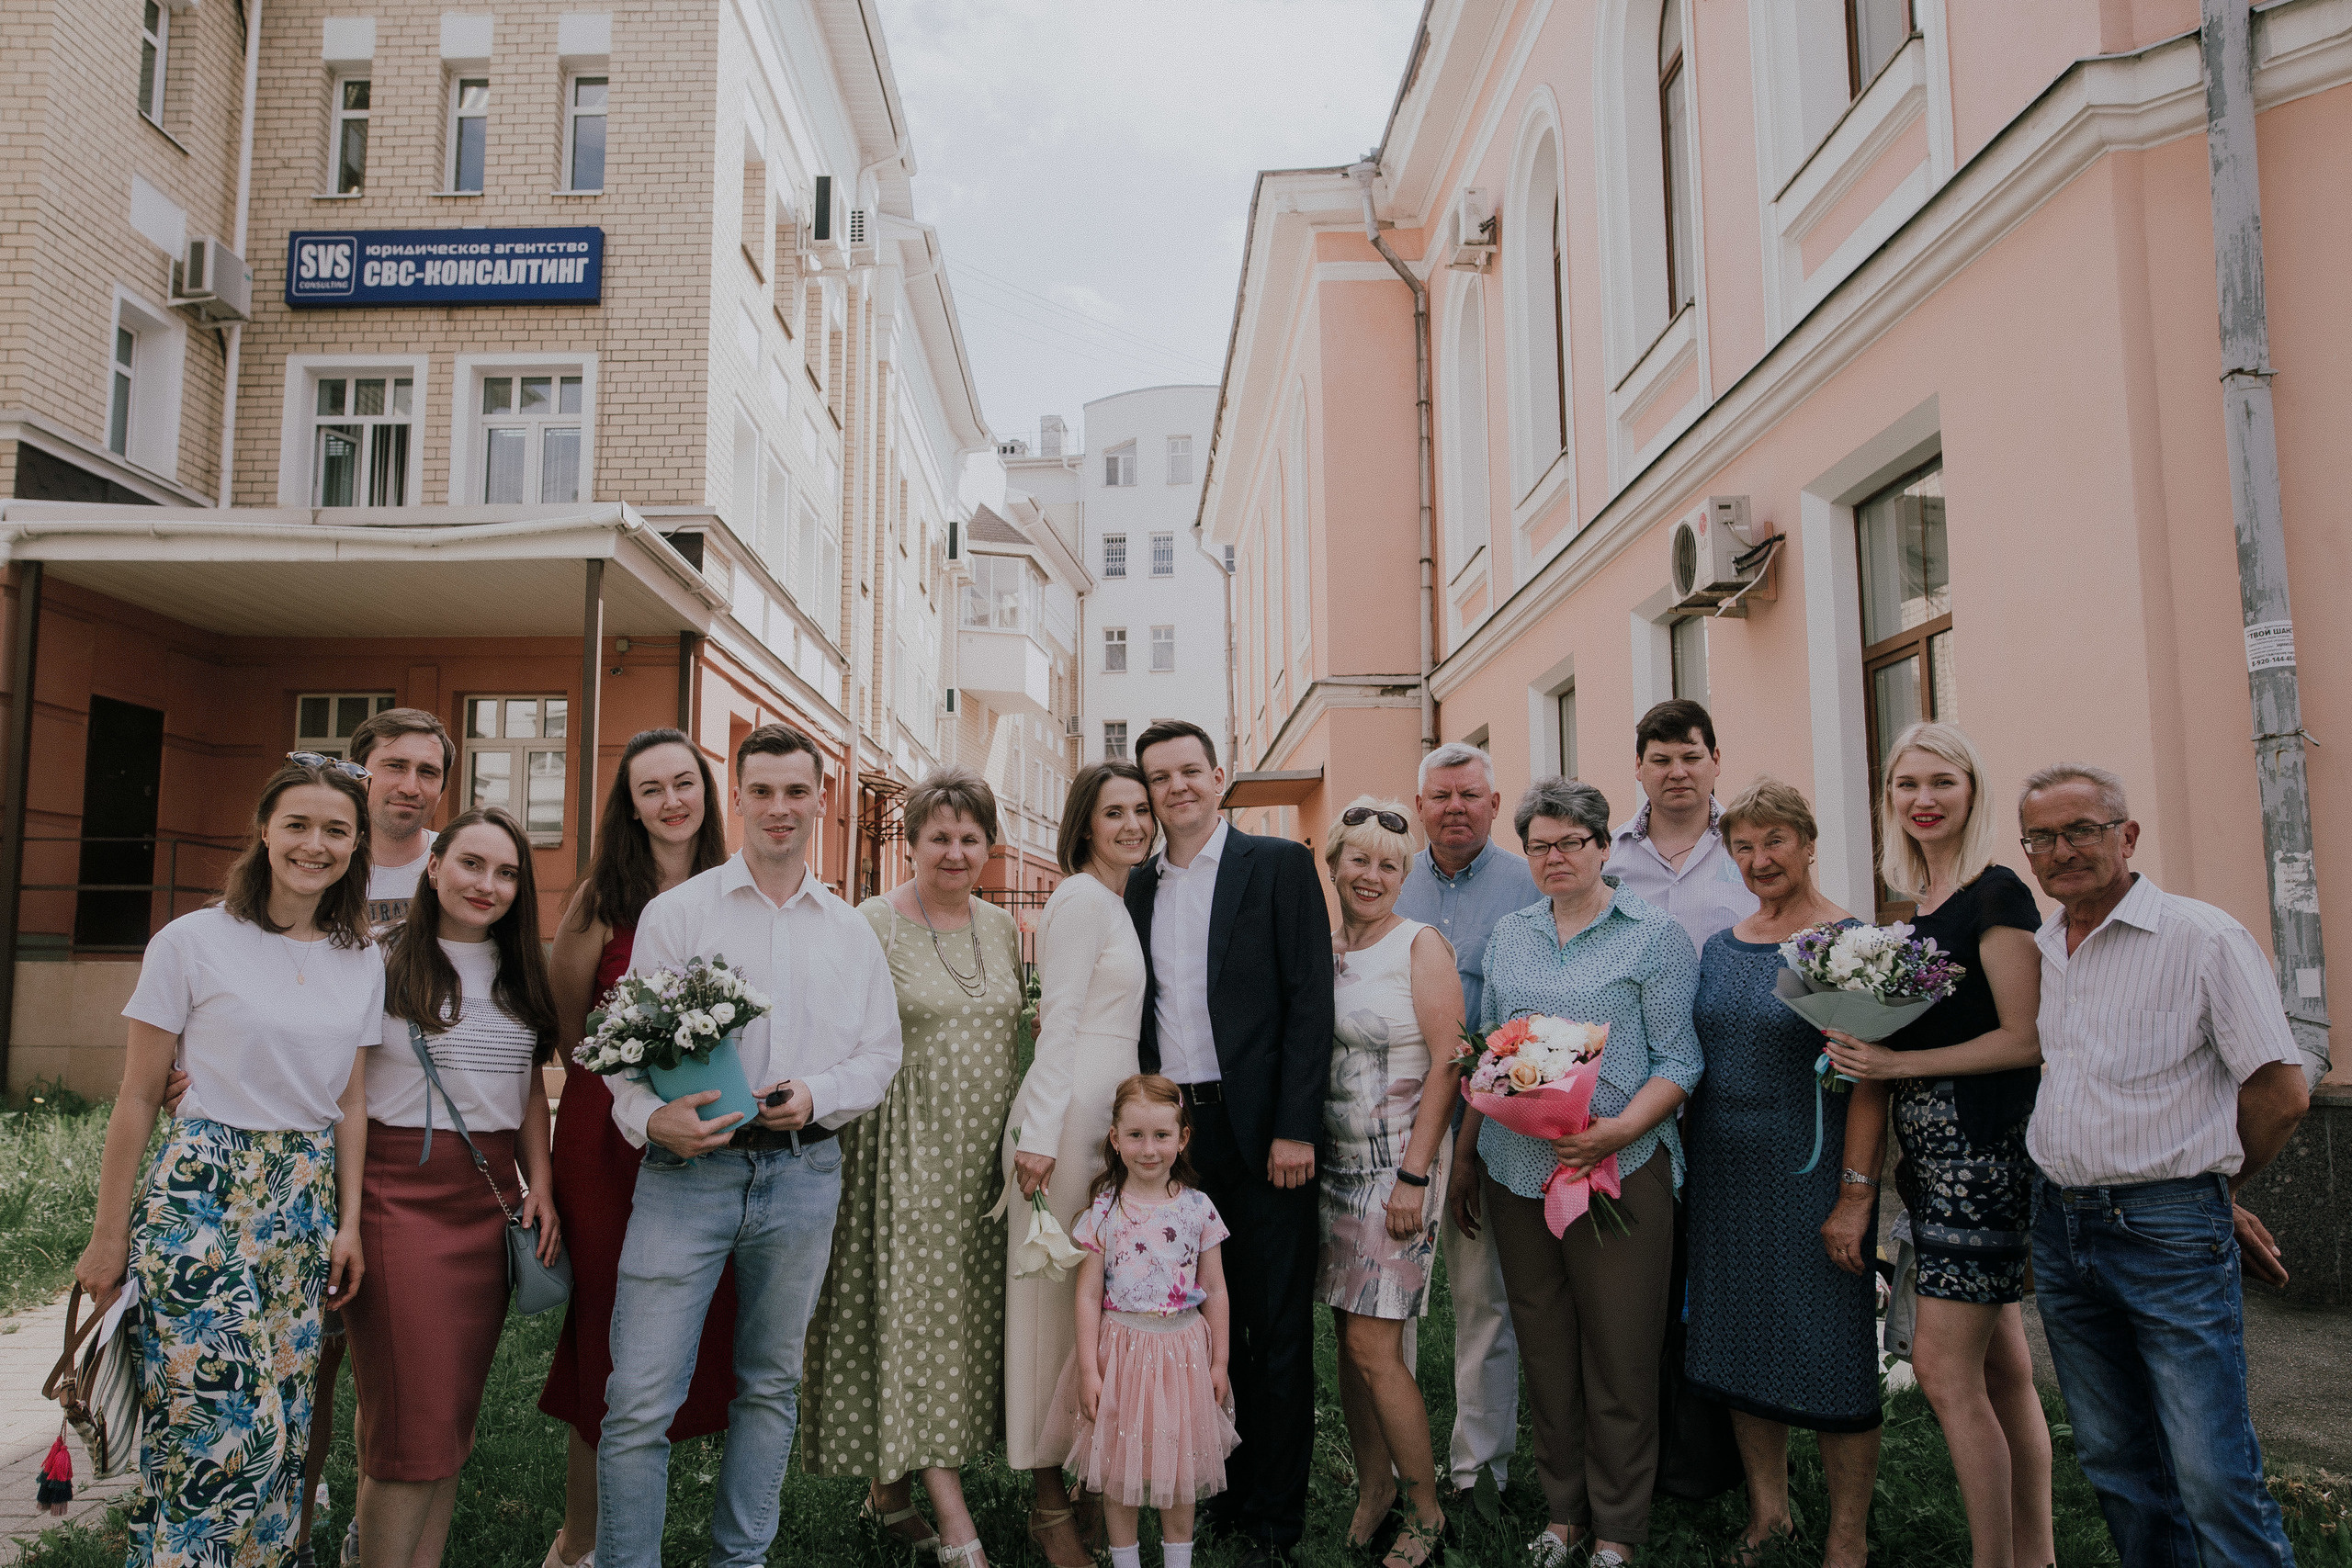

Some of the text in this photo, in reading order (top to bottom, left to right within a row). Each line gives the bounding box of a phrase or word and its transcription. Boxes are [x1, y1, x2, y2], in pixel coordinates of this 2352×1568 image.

[300, 243, 351, 279] SVS
[366, 242, 589, 258] юридическое агентство
[363, 257, 590, 287] СВС-КОНСАЛТИНГ
[299, 280, 349, 289] CONSULTING
